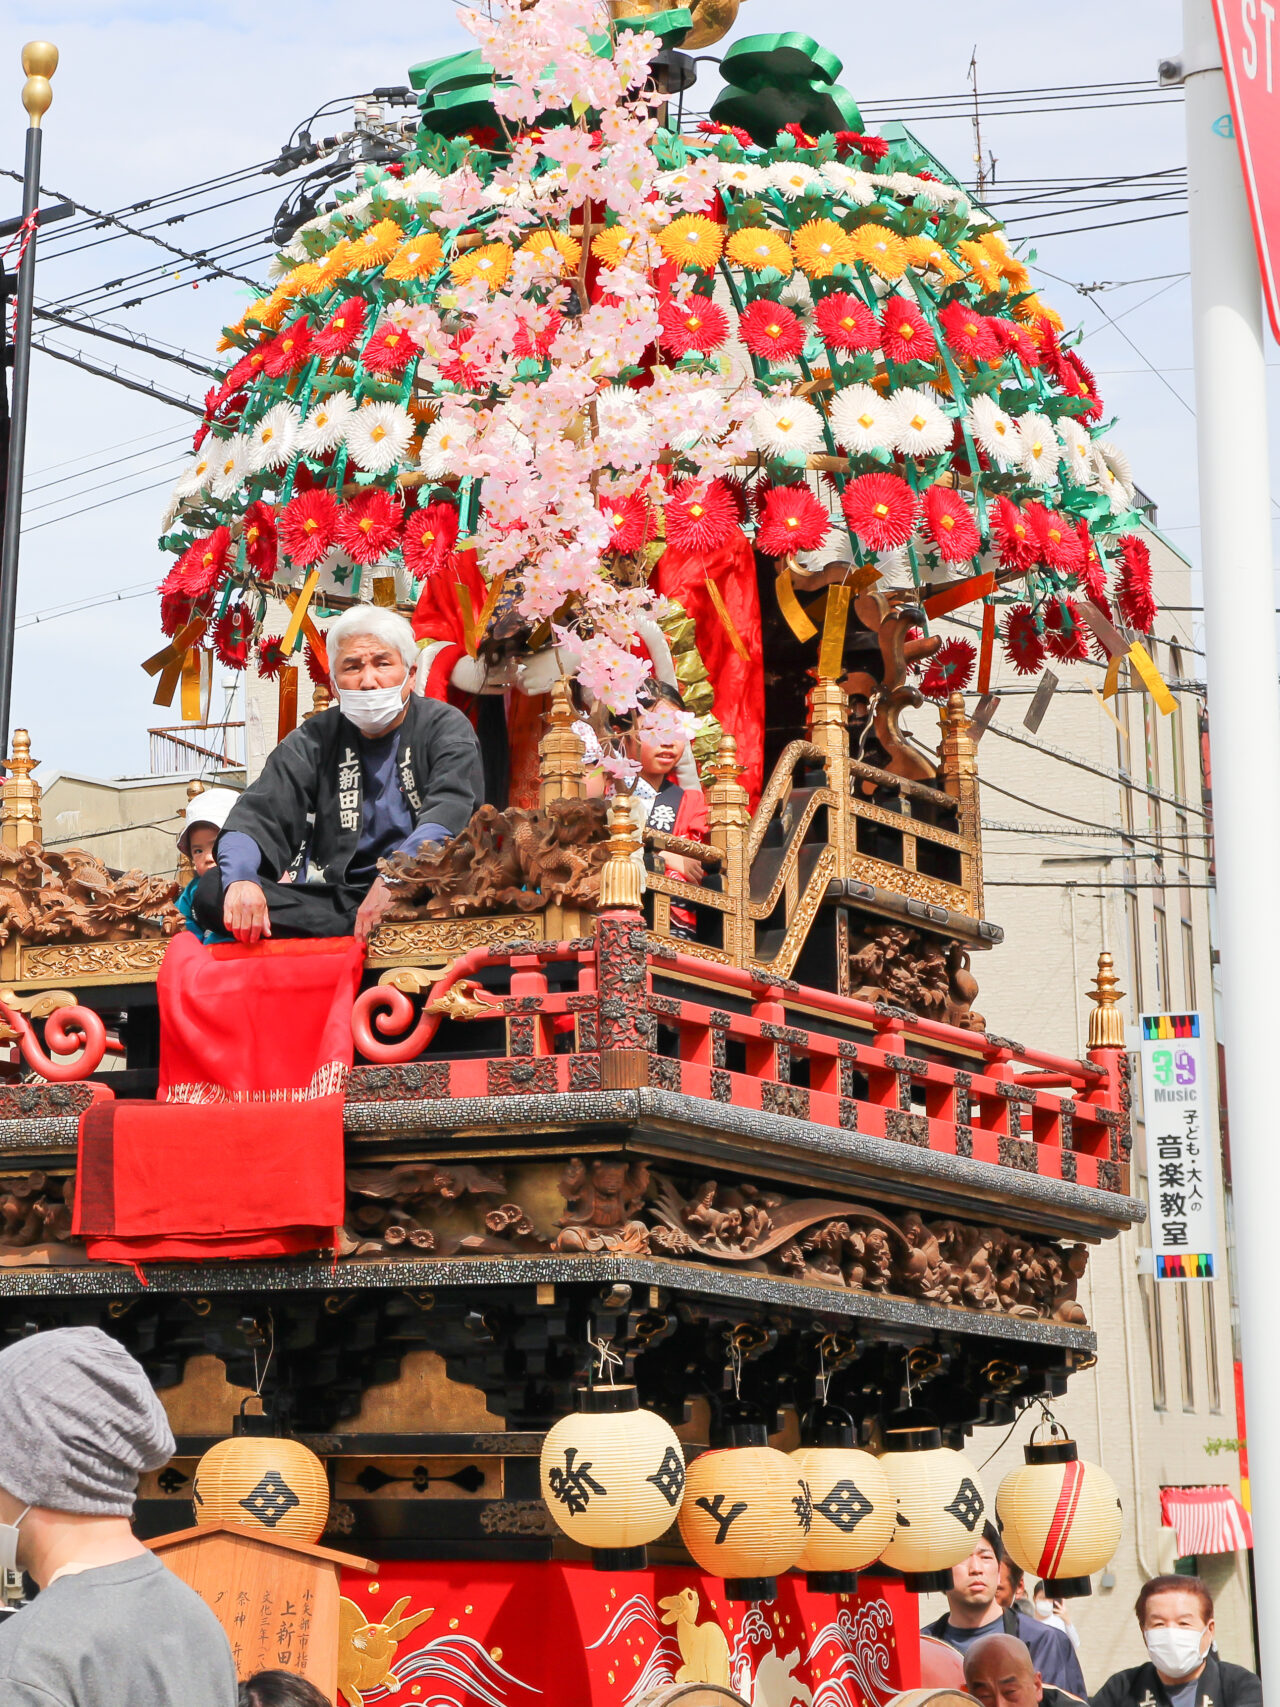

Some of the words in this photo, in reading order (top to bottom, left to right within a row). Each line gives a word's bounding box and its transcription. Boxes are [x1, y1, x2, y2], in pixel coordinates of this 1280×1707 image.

[337, 747, 361, 832] 上新田町
[399, 746, 423, 816] 上新田
[649, 804, 676, 831] 祭
[1152, 1050, 1196, 1086] 39
[1154, 1088, 1198, 1102] Music
[1157, 1134, 1189, 1246] 音楽教室
[1183, 1109, 1204, 1212] 子ども・大人の
[276, 1600, 296, 1666] 上新田
[294, 1588, 314, 1675] 小矢部市指
